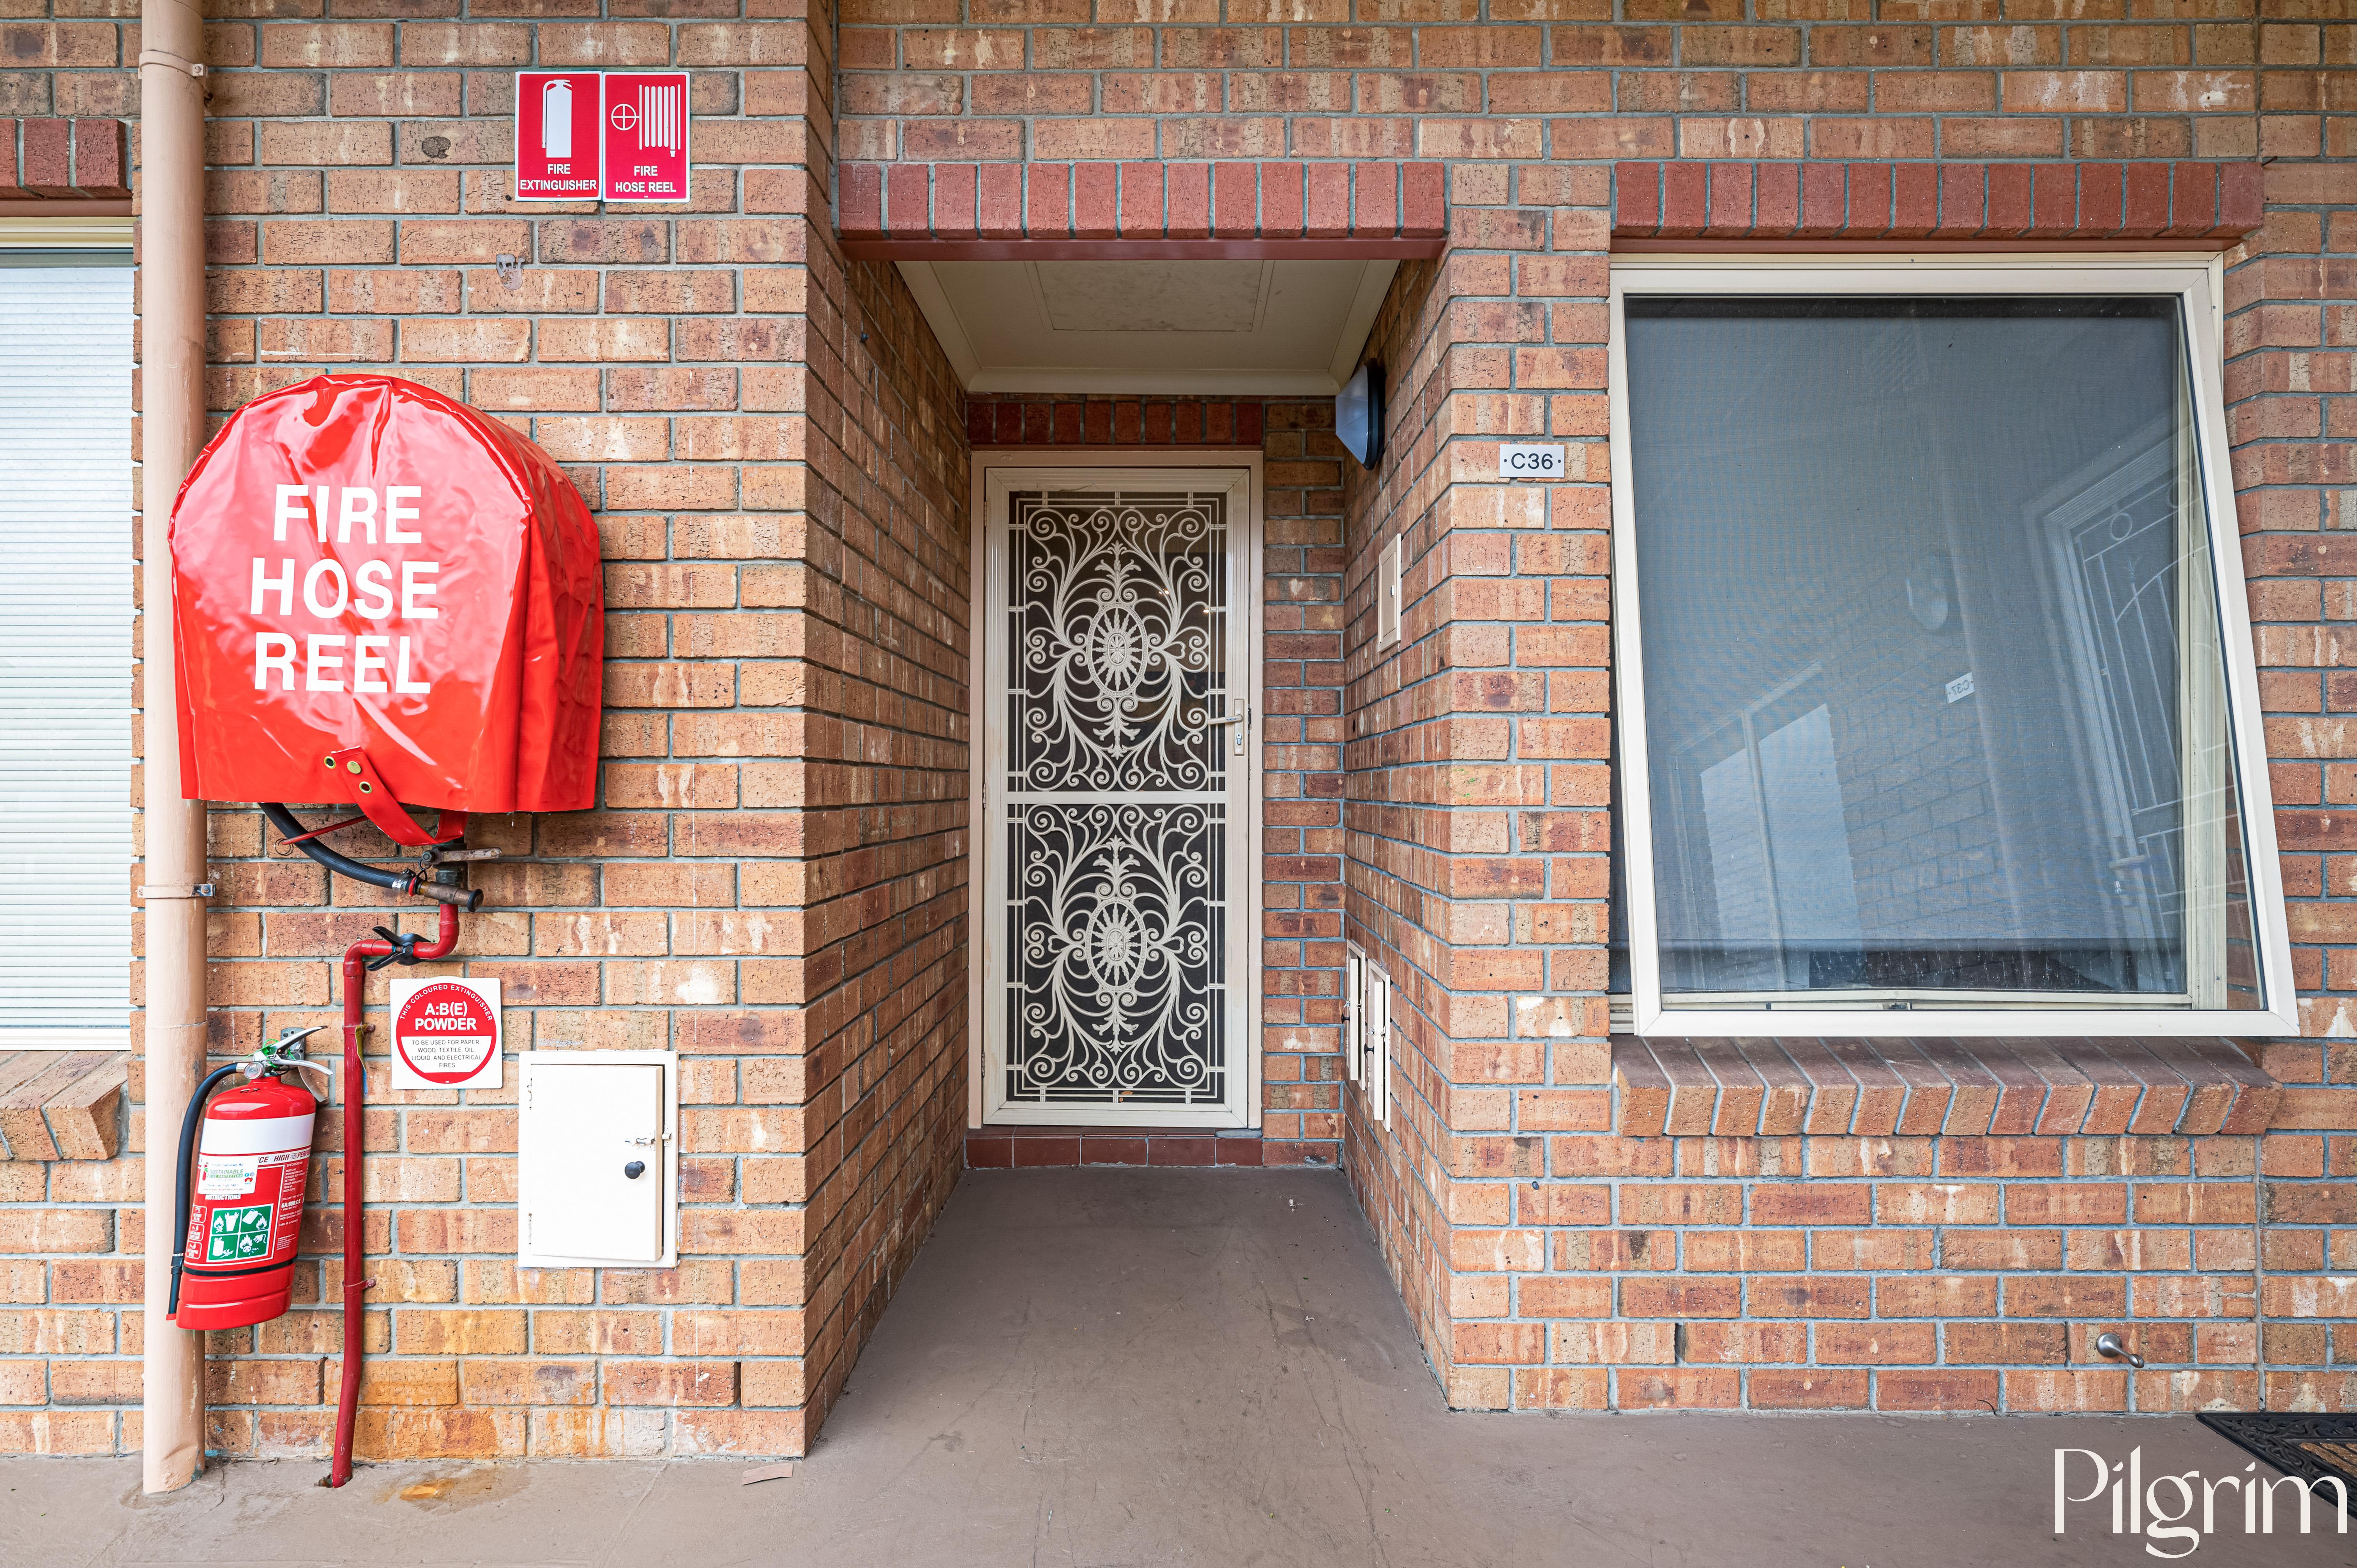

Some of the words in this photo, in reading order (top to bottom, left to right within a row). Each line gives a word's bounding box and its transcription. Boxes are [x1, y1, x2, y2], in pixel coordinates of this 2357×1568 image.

[547, 164, 571, 174] FIRE
[634, 166, 658, 176] FIRE
[520, 179, 597, 191] EXTINGUISHER
[615, 182, 645, 192] HOSE
[648, 182, 677, 192] REEL
[1511, 453, 1553, 470] C36
[273, 484, 422, 544] FIRE
[250, 557, 439, 620] HOSE
[254, 632, 431, 695] REEL
[400, 1005, 411, 1020] THIS
[410, 984, 448, 1004] COLOURED
[451, 985, 493, 1021] EXTINGUISHER
[425, 1001, 468, 1017] A:B(E)
[415, 1017, 477, 1031] POWDER
